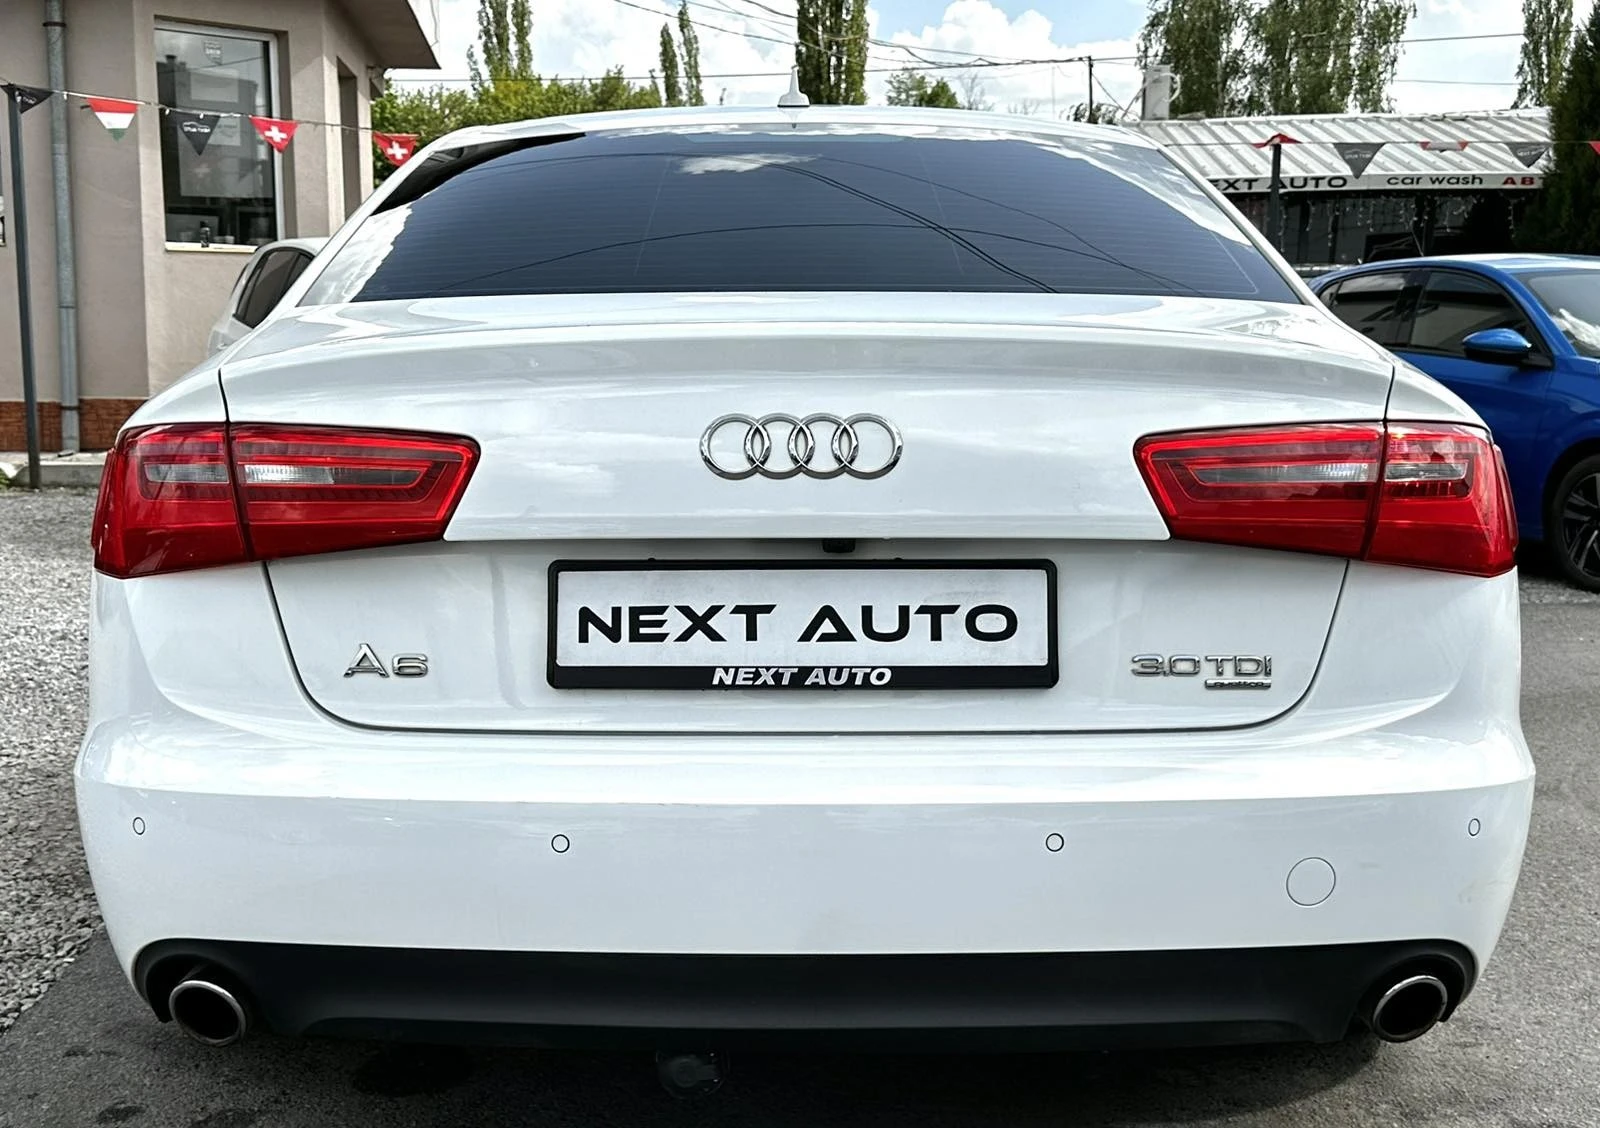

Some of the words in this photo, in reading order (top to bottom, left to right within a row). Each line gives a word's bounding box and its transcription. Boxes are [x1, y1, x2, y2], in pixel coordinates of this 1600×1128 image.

[1266, 176, 1347, 190] AUTO
[1386, 176, 1422, 186] car
[1429, 174, 1484, 186] wash
[578, 604, 777, 643] NEXT
[797, 604, 1019, 643] AUTO
[343, 642, 428, 678] A6
[1205, 654, 1272, 676] TDI
[711, 667, 799, 686] NEXT
[804, 667, 893, 686] AUTO
